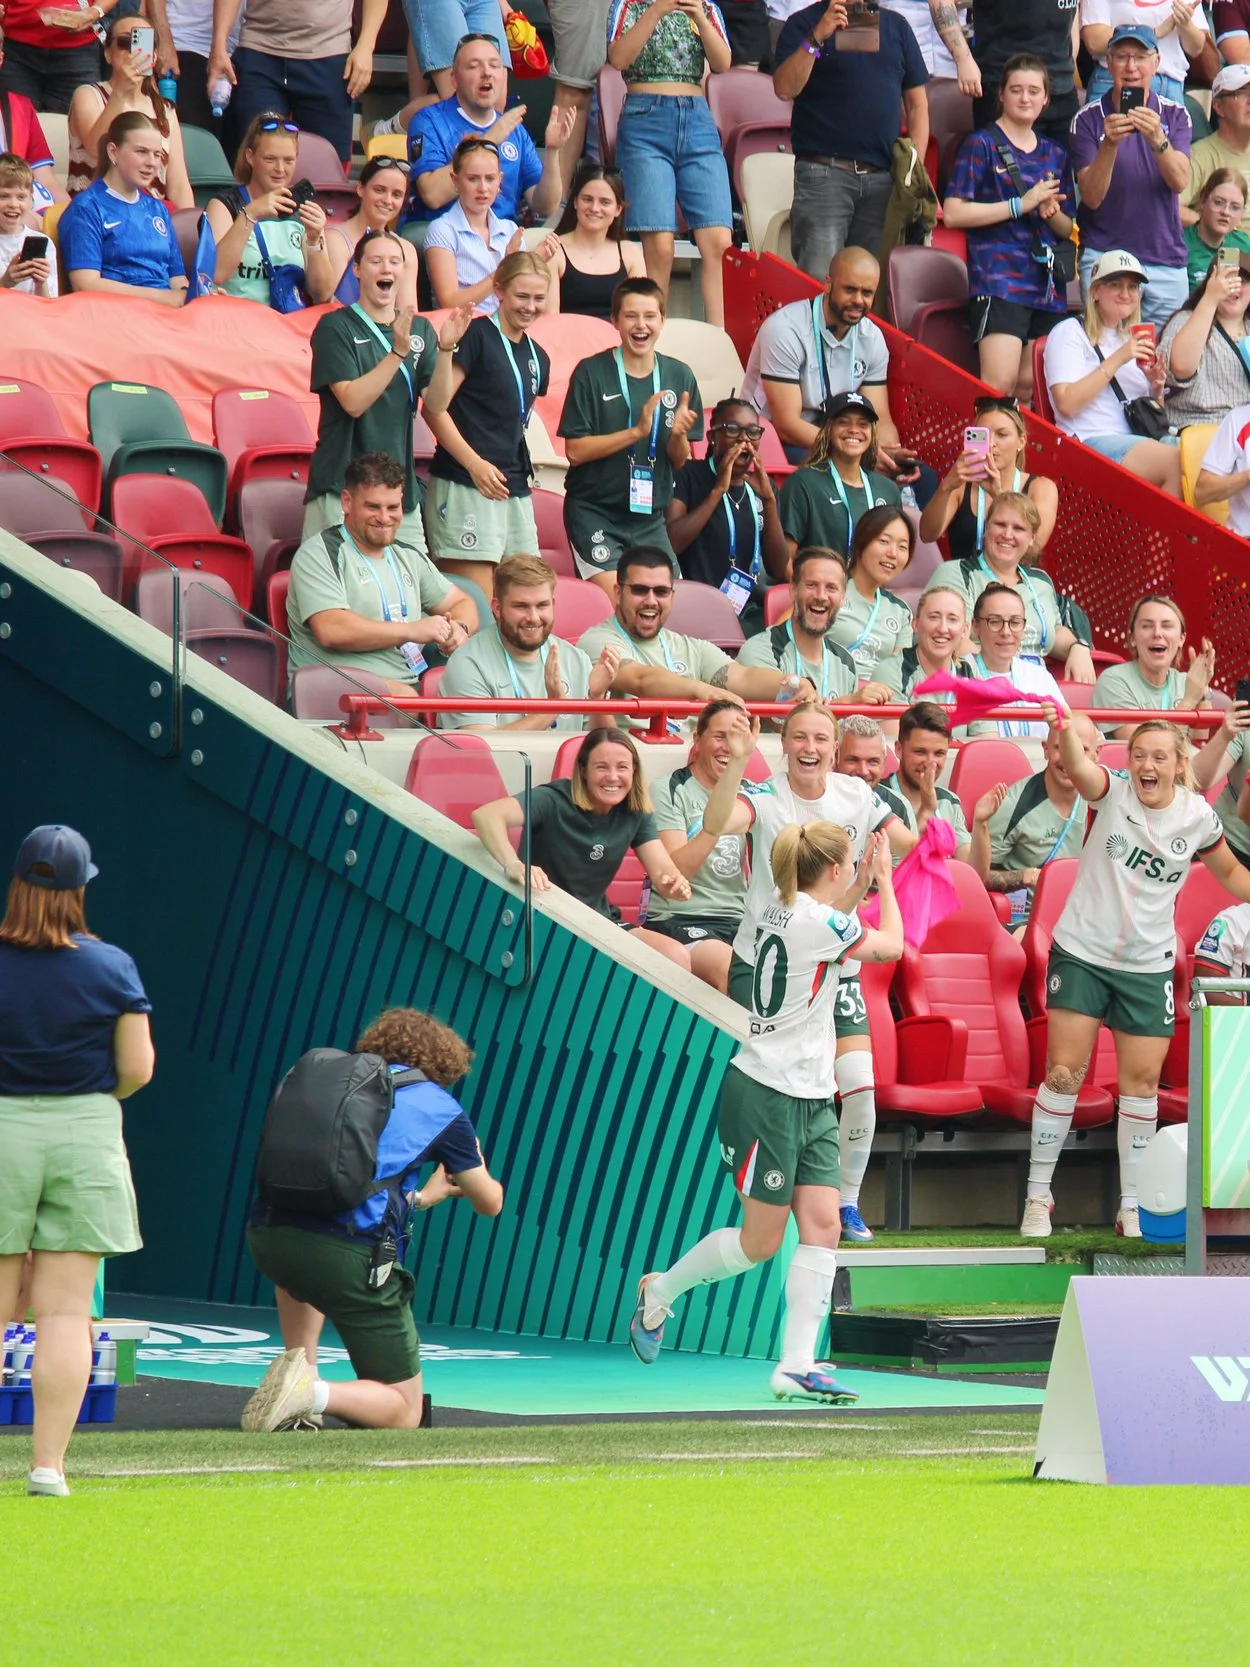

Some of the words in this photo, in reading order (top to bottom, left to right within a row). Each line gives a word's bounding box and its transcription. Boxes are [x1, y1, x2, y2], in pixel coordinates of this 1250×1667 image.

[237, 263, 270, 280] triv
[1125, 846, 1184, 884] IFS.a
[763, 904, 794, 929] WALSH
[836, 981, 866, 1017] 33
[1164, 980, 1175, 1015] 8
